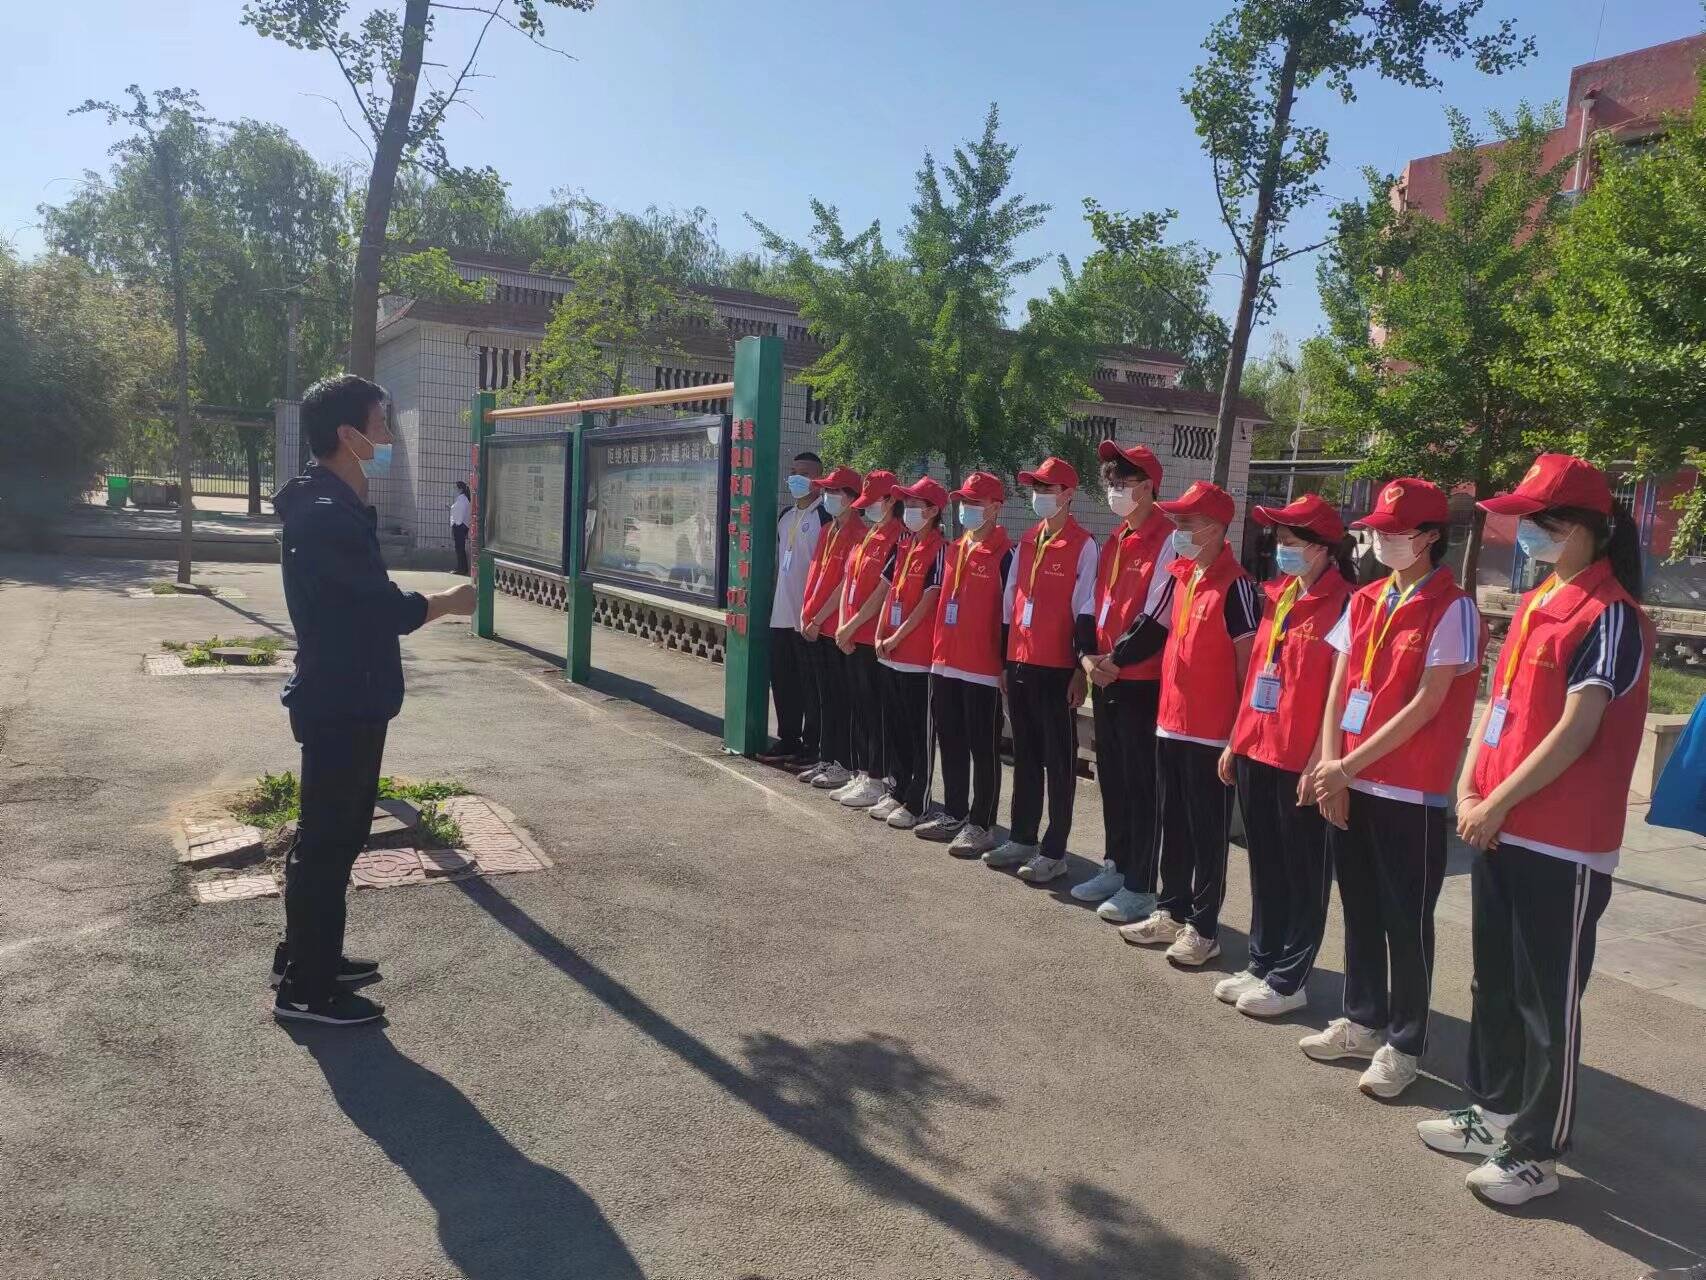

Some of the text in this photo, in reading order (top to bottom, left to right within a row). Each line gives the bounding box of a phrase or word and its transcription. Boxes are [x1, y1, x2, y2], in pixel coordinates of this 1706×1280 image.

[607, 444, 656, 464] 拒绝校园暴力
